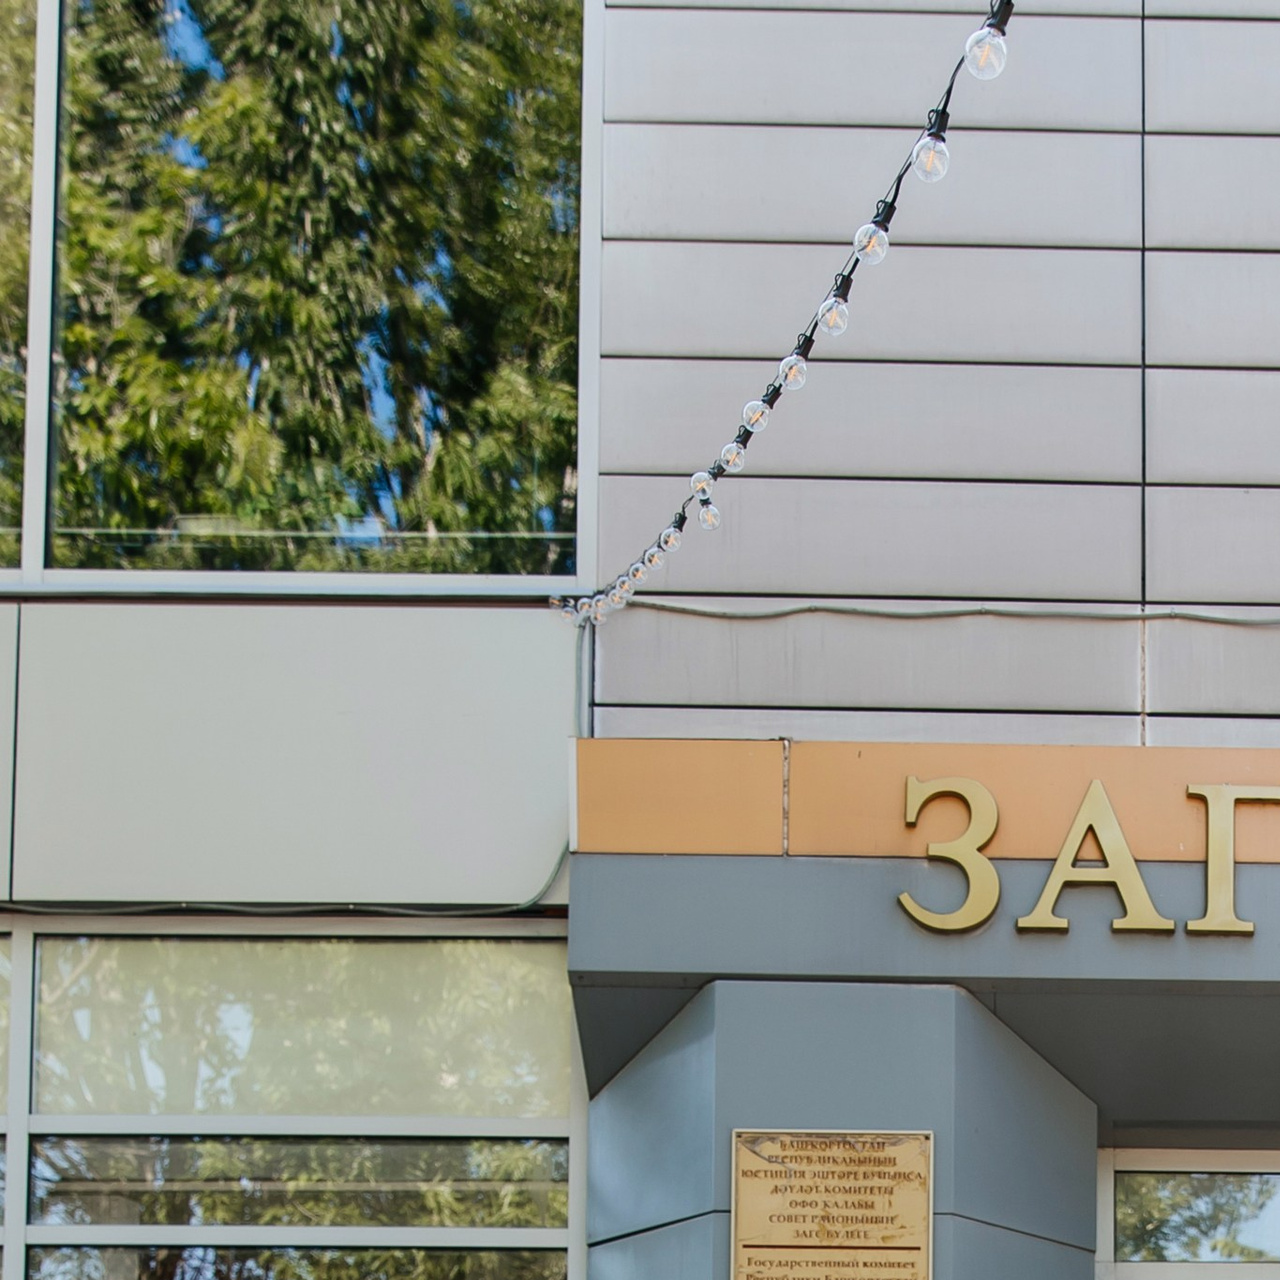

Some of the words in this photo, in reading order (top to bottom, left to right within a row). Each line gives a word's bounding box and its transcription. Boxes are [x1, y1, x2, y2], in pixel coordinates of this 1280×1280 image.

[824, 1185, 894, 1196] КОМИТЕТЫ
[769, 1214, 808, 1223] СОВЕТ
[794, 1229, 821, 1239] ЗАГС
[747, 1257, 859, 1271] Государственный
[863, 1260, 916, 1269] комитет
